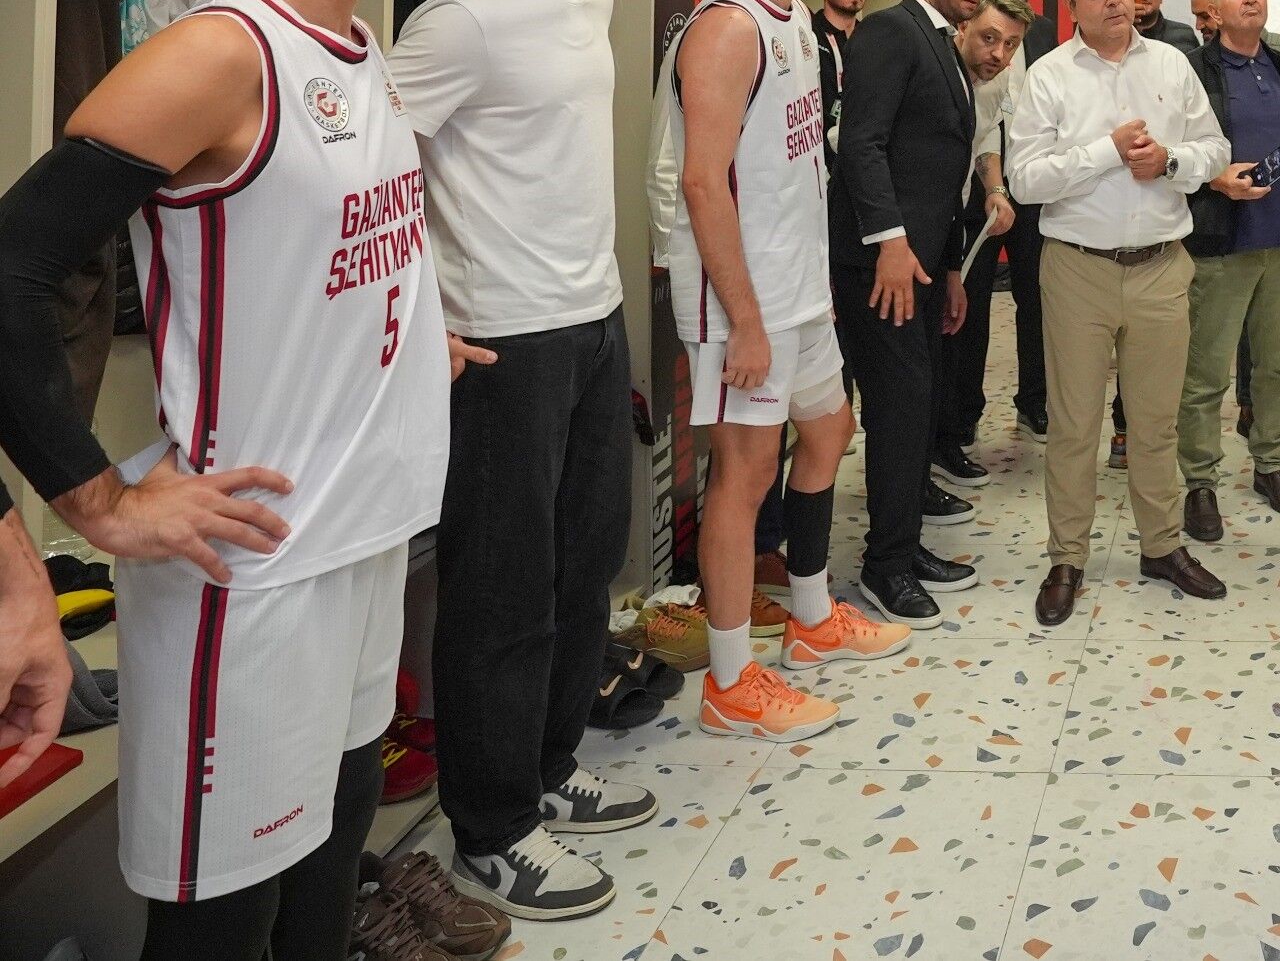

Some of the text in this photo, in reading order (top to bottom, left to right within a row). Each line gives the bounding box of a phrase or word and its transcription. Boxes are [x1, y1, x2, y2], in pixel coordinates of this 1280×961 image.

[322, 131, 357, 144] DAFRON
[380, 284, 400, 368] 5
[253, 803, 304, 839] DAFRON
